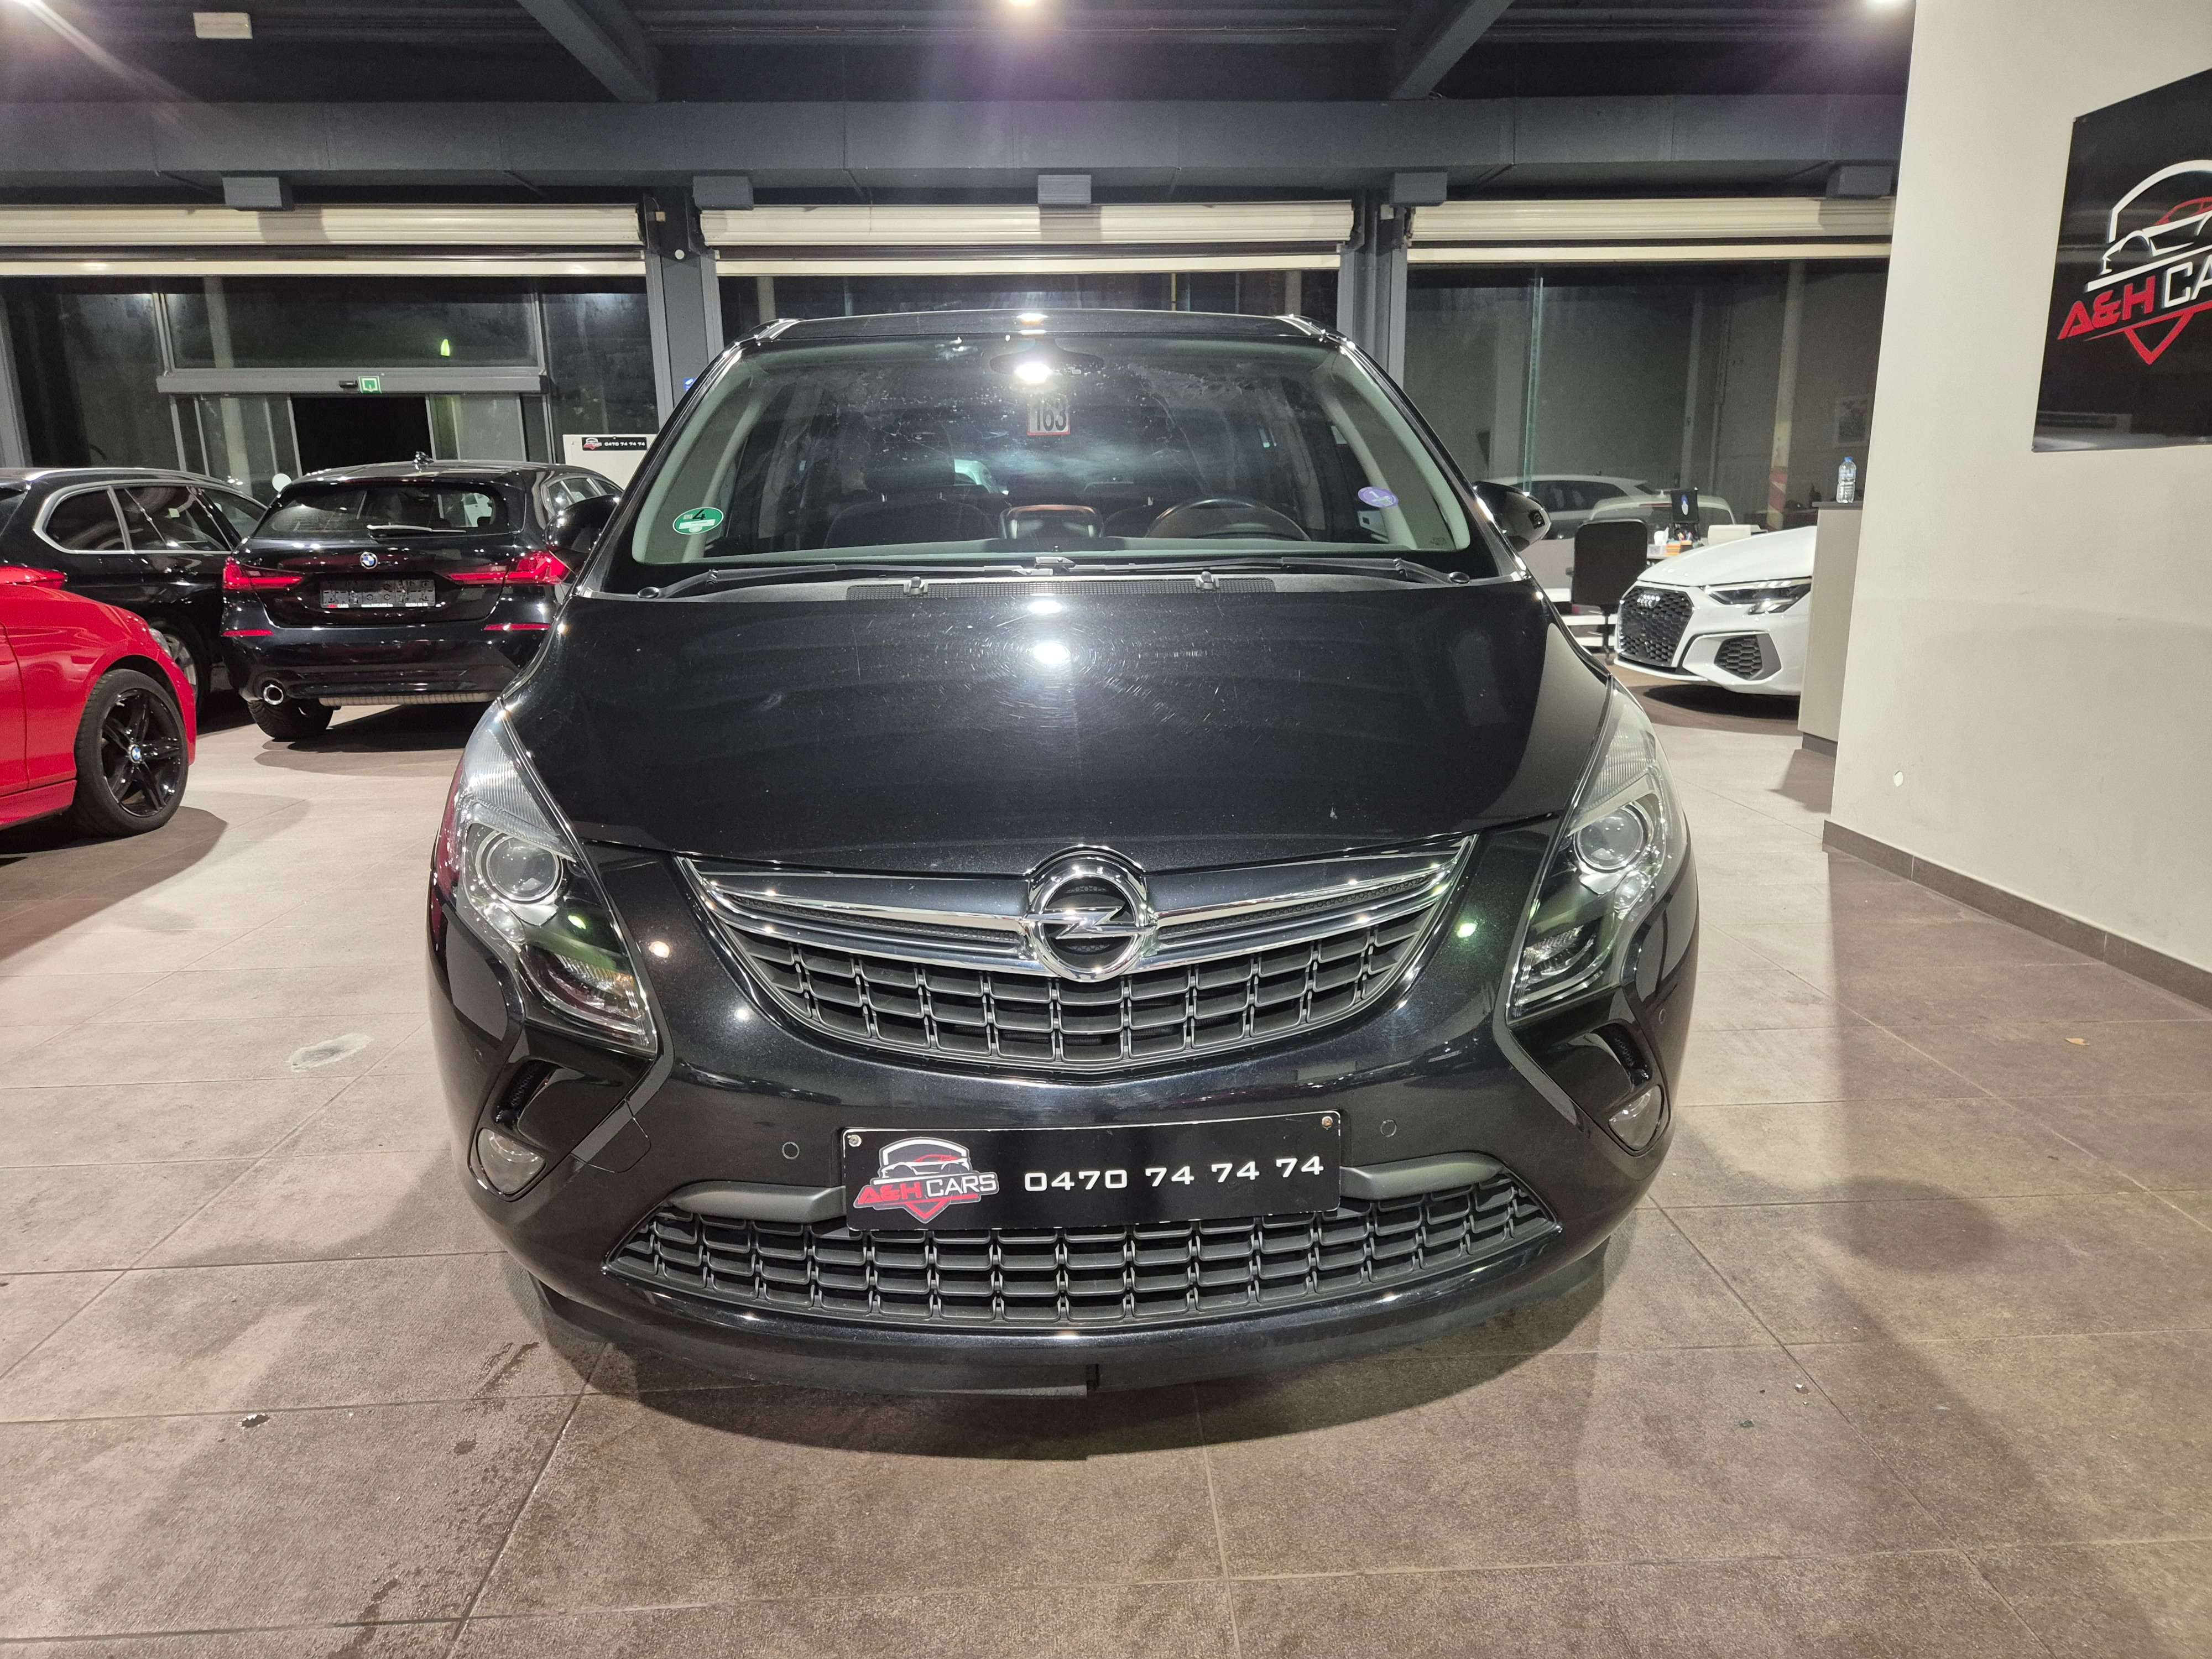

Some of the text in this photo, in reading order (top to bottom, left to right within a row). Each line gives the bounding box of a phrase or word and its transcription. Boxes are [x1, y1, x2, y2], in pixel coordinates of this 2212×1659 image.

[2057, 275, 2156, 340] A&H
[692, 509, 706, 520] 4
[857, 1173, 997, 1205] A&H CARS
[1024, 1156, 1324, 1192] 0470 74 74 74
